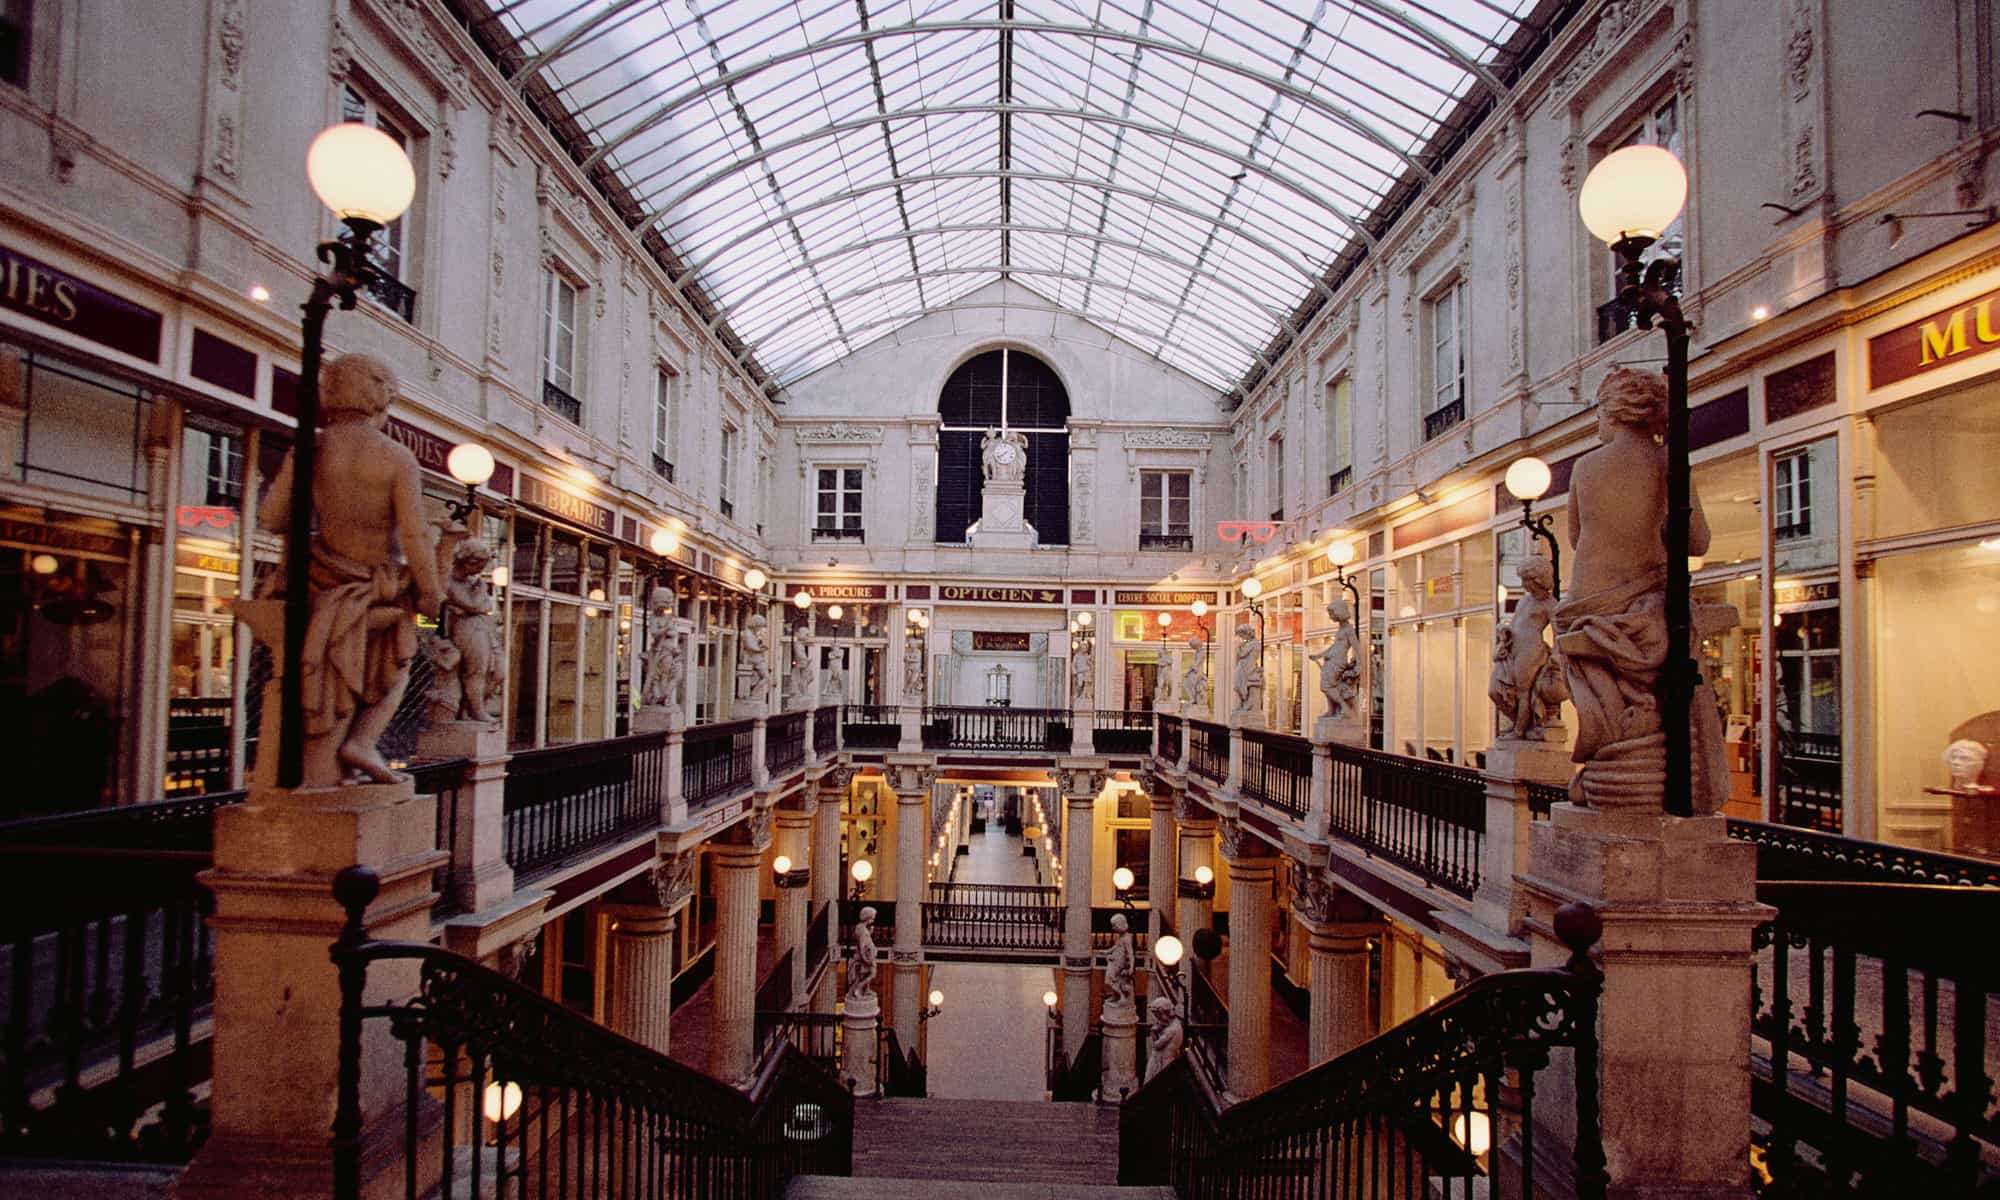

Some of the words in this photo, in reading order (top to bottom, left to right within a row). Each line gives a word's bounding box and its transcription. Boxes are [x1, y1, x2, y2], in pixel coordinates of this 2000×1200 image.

[0, 258, 77, 321] IES
[1918, 297, 2000, 367] MU
[532, 481, 607, 529] LIBRAIRIE
[820, 586, 873, 598] PROCURE
[944, 587, 1034, 601] OPTICIEN
